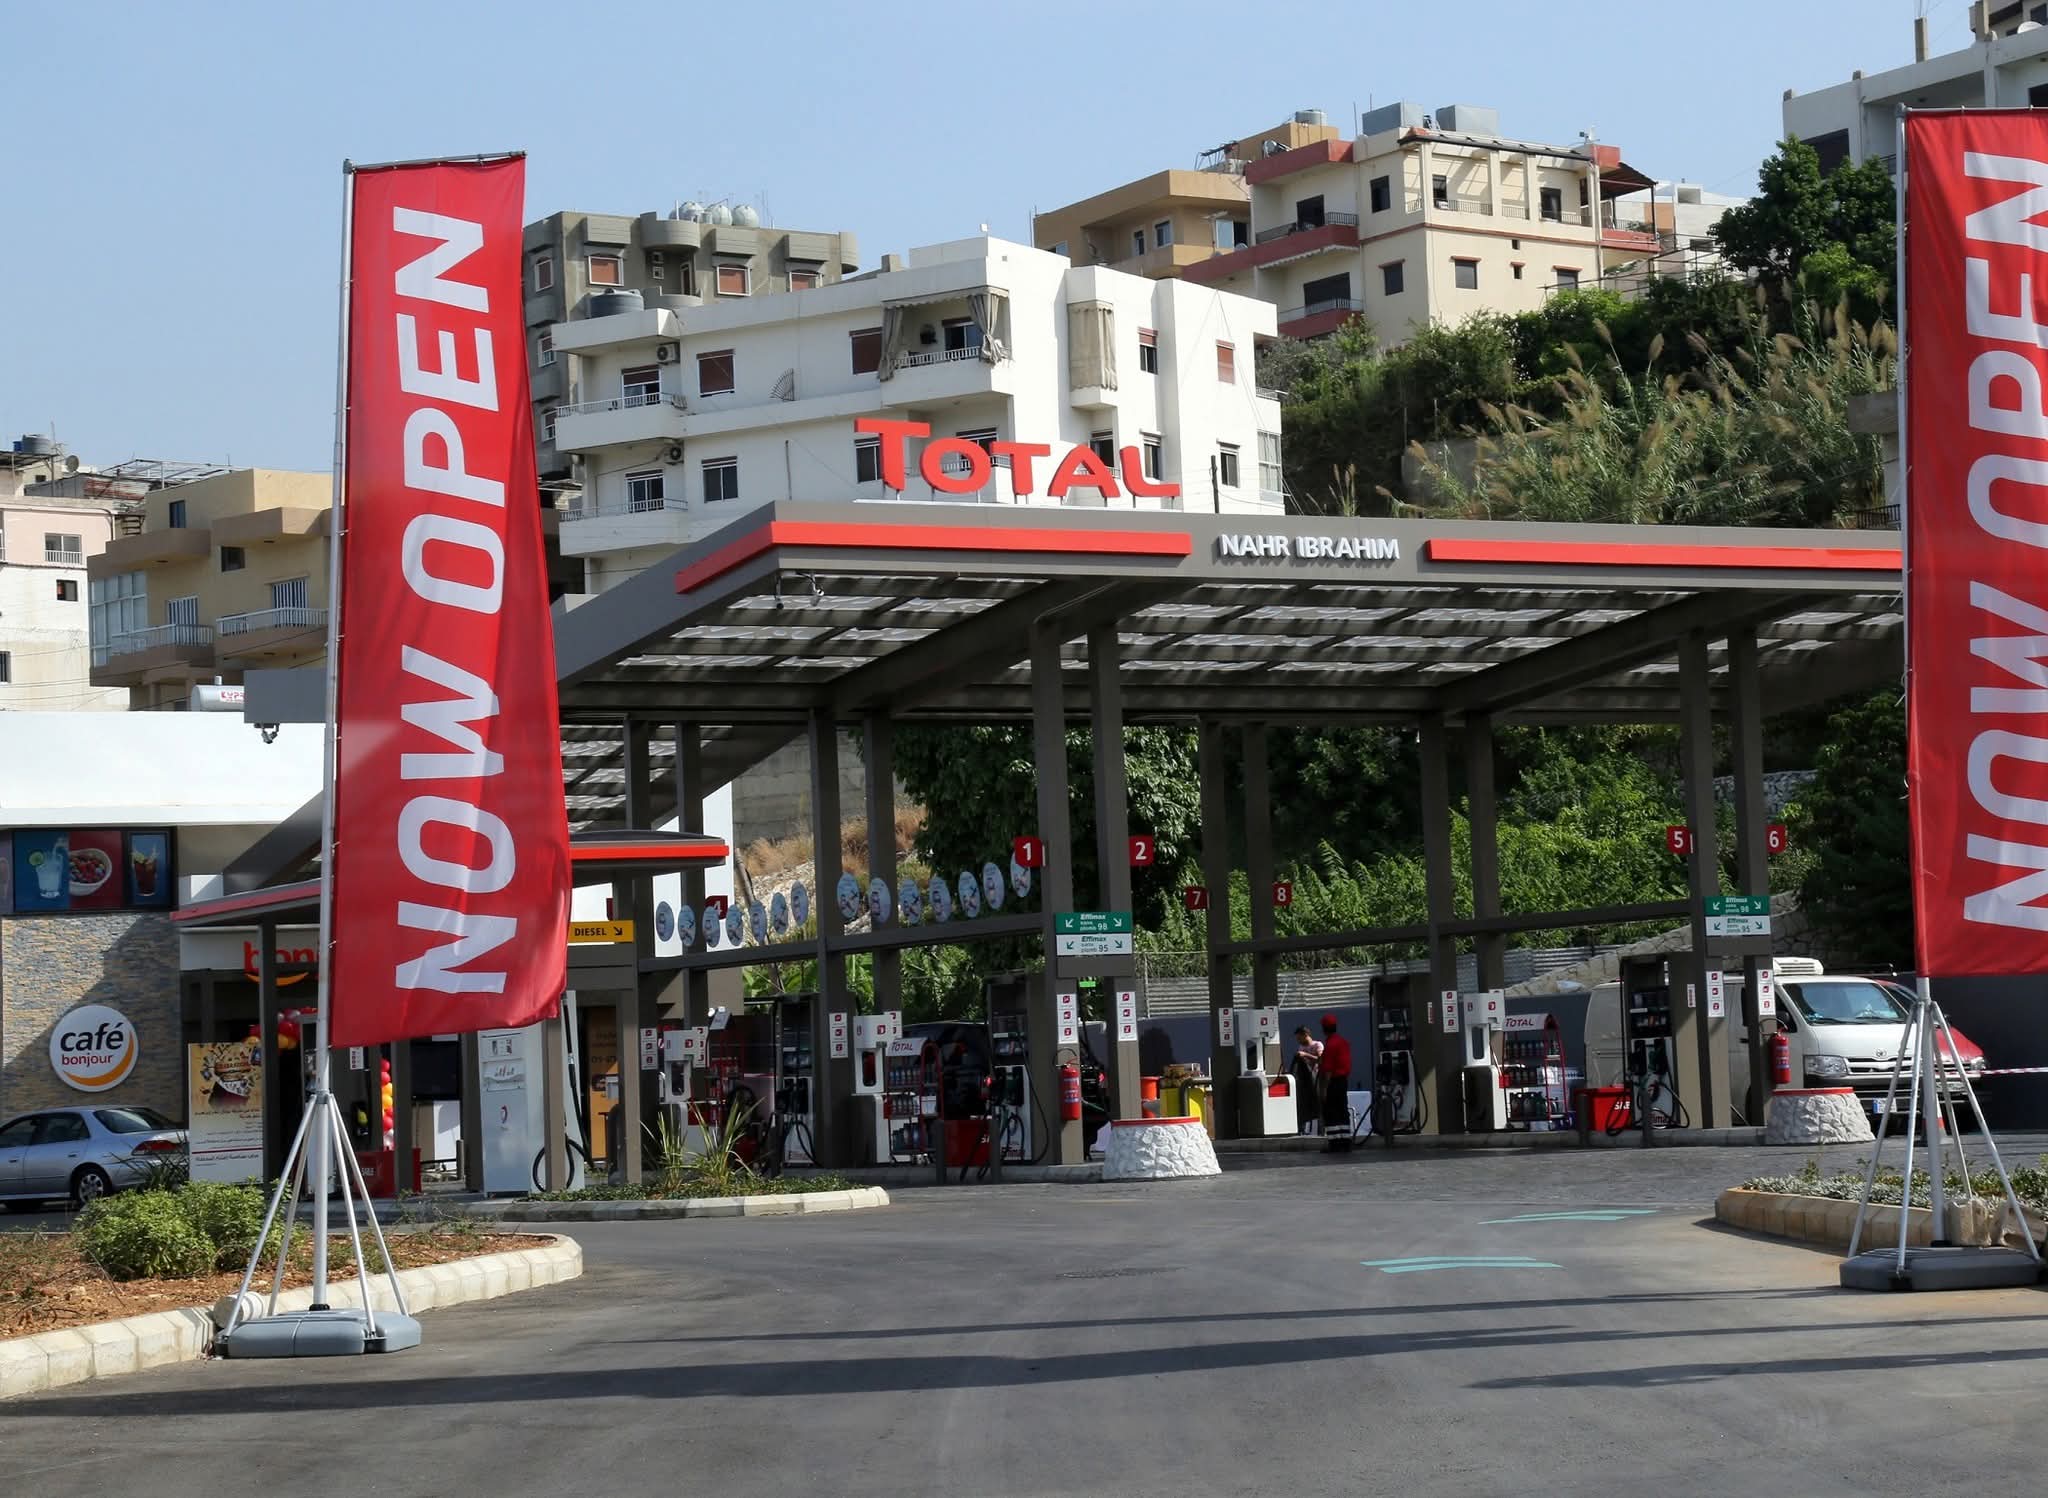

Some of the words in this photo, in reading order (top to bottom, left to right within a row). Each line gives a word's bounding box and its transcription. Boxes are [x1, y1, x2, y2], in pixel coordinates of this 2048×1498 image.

[1964, 151, 2048, 549] OPEN
[393, 206, 505, 614] OPEN
[854, 418, 1180, 497] TOTAL
[1220, 534, 1290, 556] NAHR
[1296, 536, 1400, 559] IBRAHIM
[1964, 580, 2048, 931] NOW
[395, 645, 517, 993] NOW
[1674, 830, 1684, 848] 5
[1769, 830, 1779, 848] 6
[1022, 842, 1031, 861] 1
[1135, 841, 1146, 860] 2
[1193, 890, 1201, 905] 7
[1277, 887, 1286, 902] 8
[713, 900, 723, 916] 4
[574, 926, 607, 936] DIESEL
[1097, 922, 1108, 931] 98
[1081, 935, 1106, 943] Effimax
[1098, 944, 1109, 952] 95
[1505, 1017, 1534, 1027] TOTAL
[60, 1022, 124, 1052] café
[891, 1041, 913, 1051] TOTAL
[61, 1052, 114, 1067] bonjour
